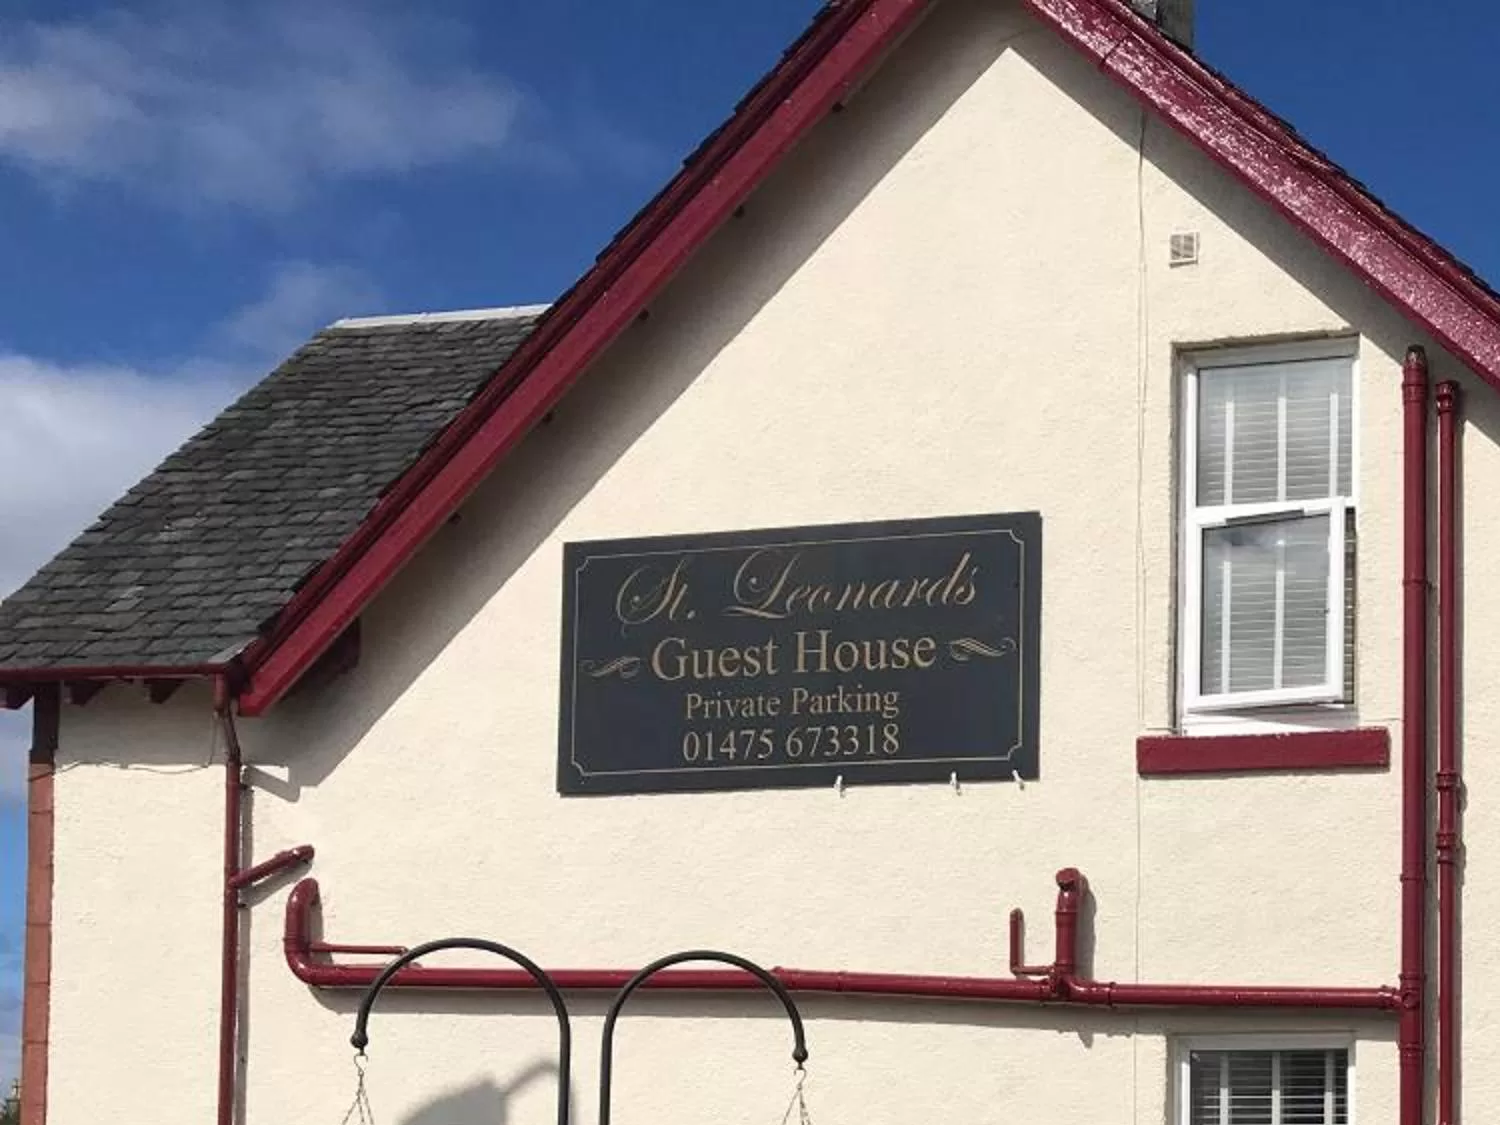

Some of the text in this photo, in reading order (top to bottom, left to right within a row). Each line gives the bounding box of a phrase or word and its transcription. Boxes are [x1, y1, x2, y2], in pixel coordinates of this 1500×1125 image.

[616, 557, 697, 639] St.
[651, 630, 937, 681] Guest House
[686, 684, 900, 720] Private Parking
[683, 722, 900, 762] 01475 673318
